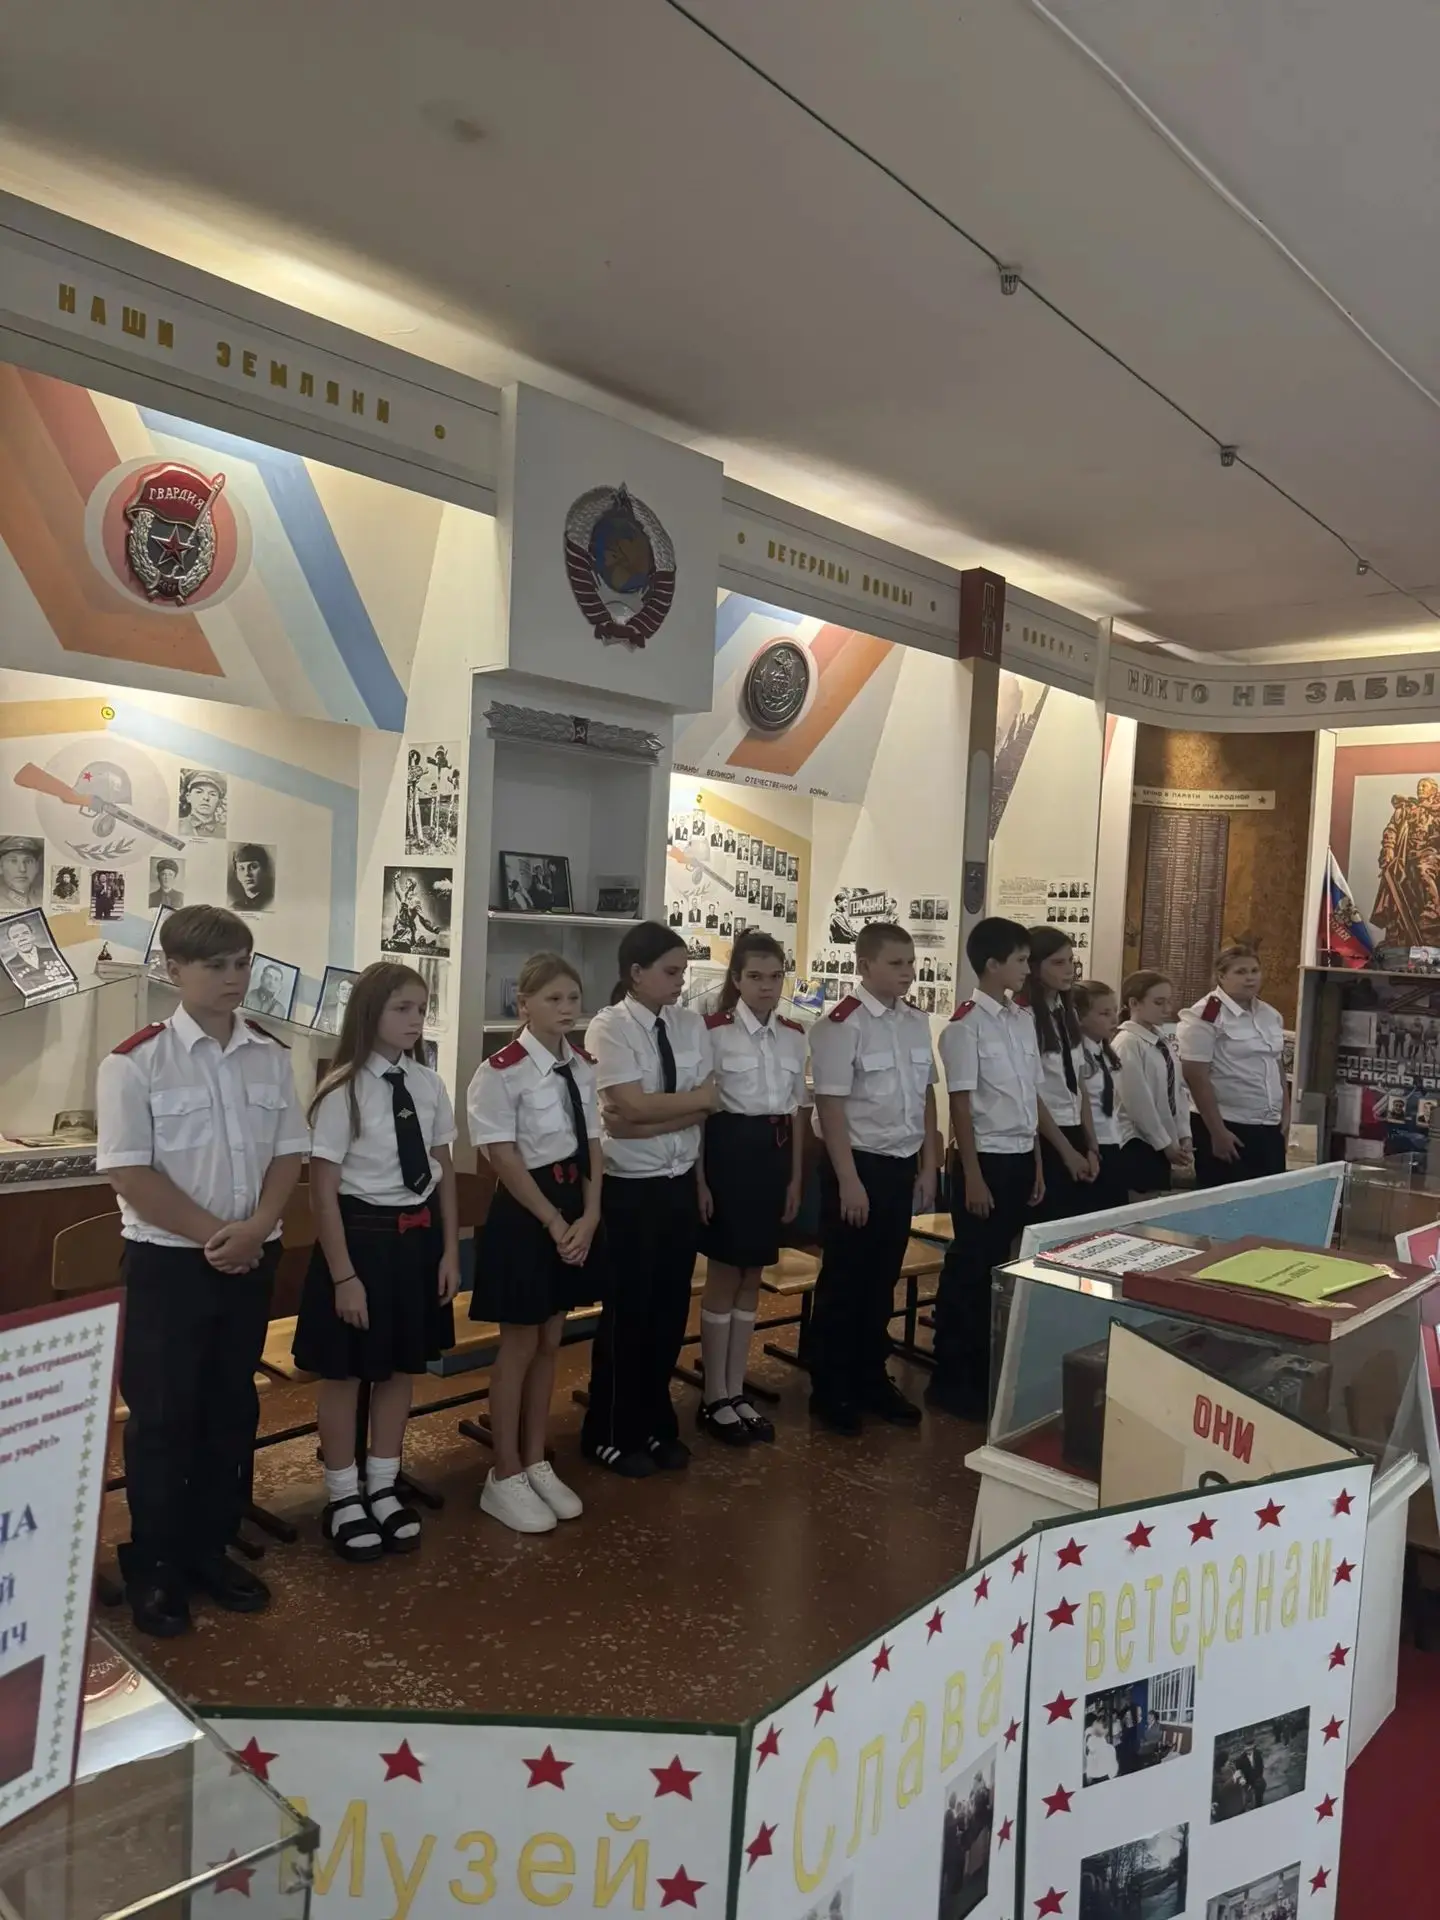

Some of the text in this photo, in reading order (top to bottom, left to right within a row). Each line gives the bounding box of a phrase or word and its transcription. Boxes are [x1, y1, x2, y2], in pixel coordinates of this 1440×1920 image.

[59, 283, 174, 349] НАШИ
[148, 487, 205, 510] ГВАРДИЯ
[767, 540, 849, 585] ВЕТЕРАНЫ
[1127, 668, 1435, 706] НИКТО НЕ ЗАБЫ
[706, 769, 735, 780] ВЕЛИКОЙ
[744, 775, 798, 792] ОТЕЧЕСТВЕННОЙ
[1193, 1394, 1255, 1465] ОНИ
[1085, 1536, 1334, 1682] ветеранам
[792, 1640, 1005, 1894] Слава
[278, 1795, 650, 1920] Музей
